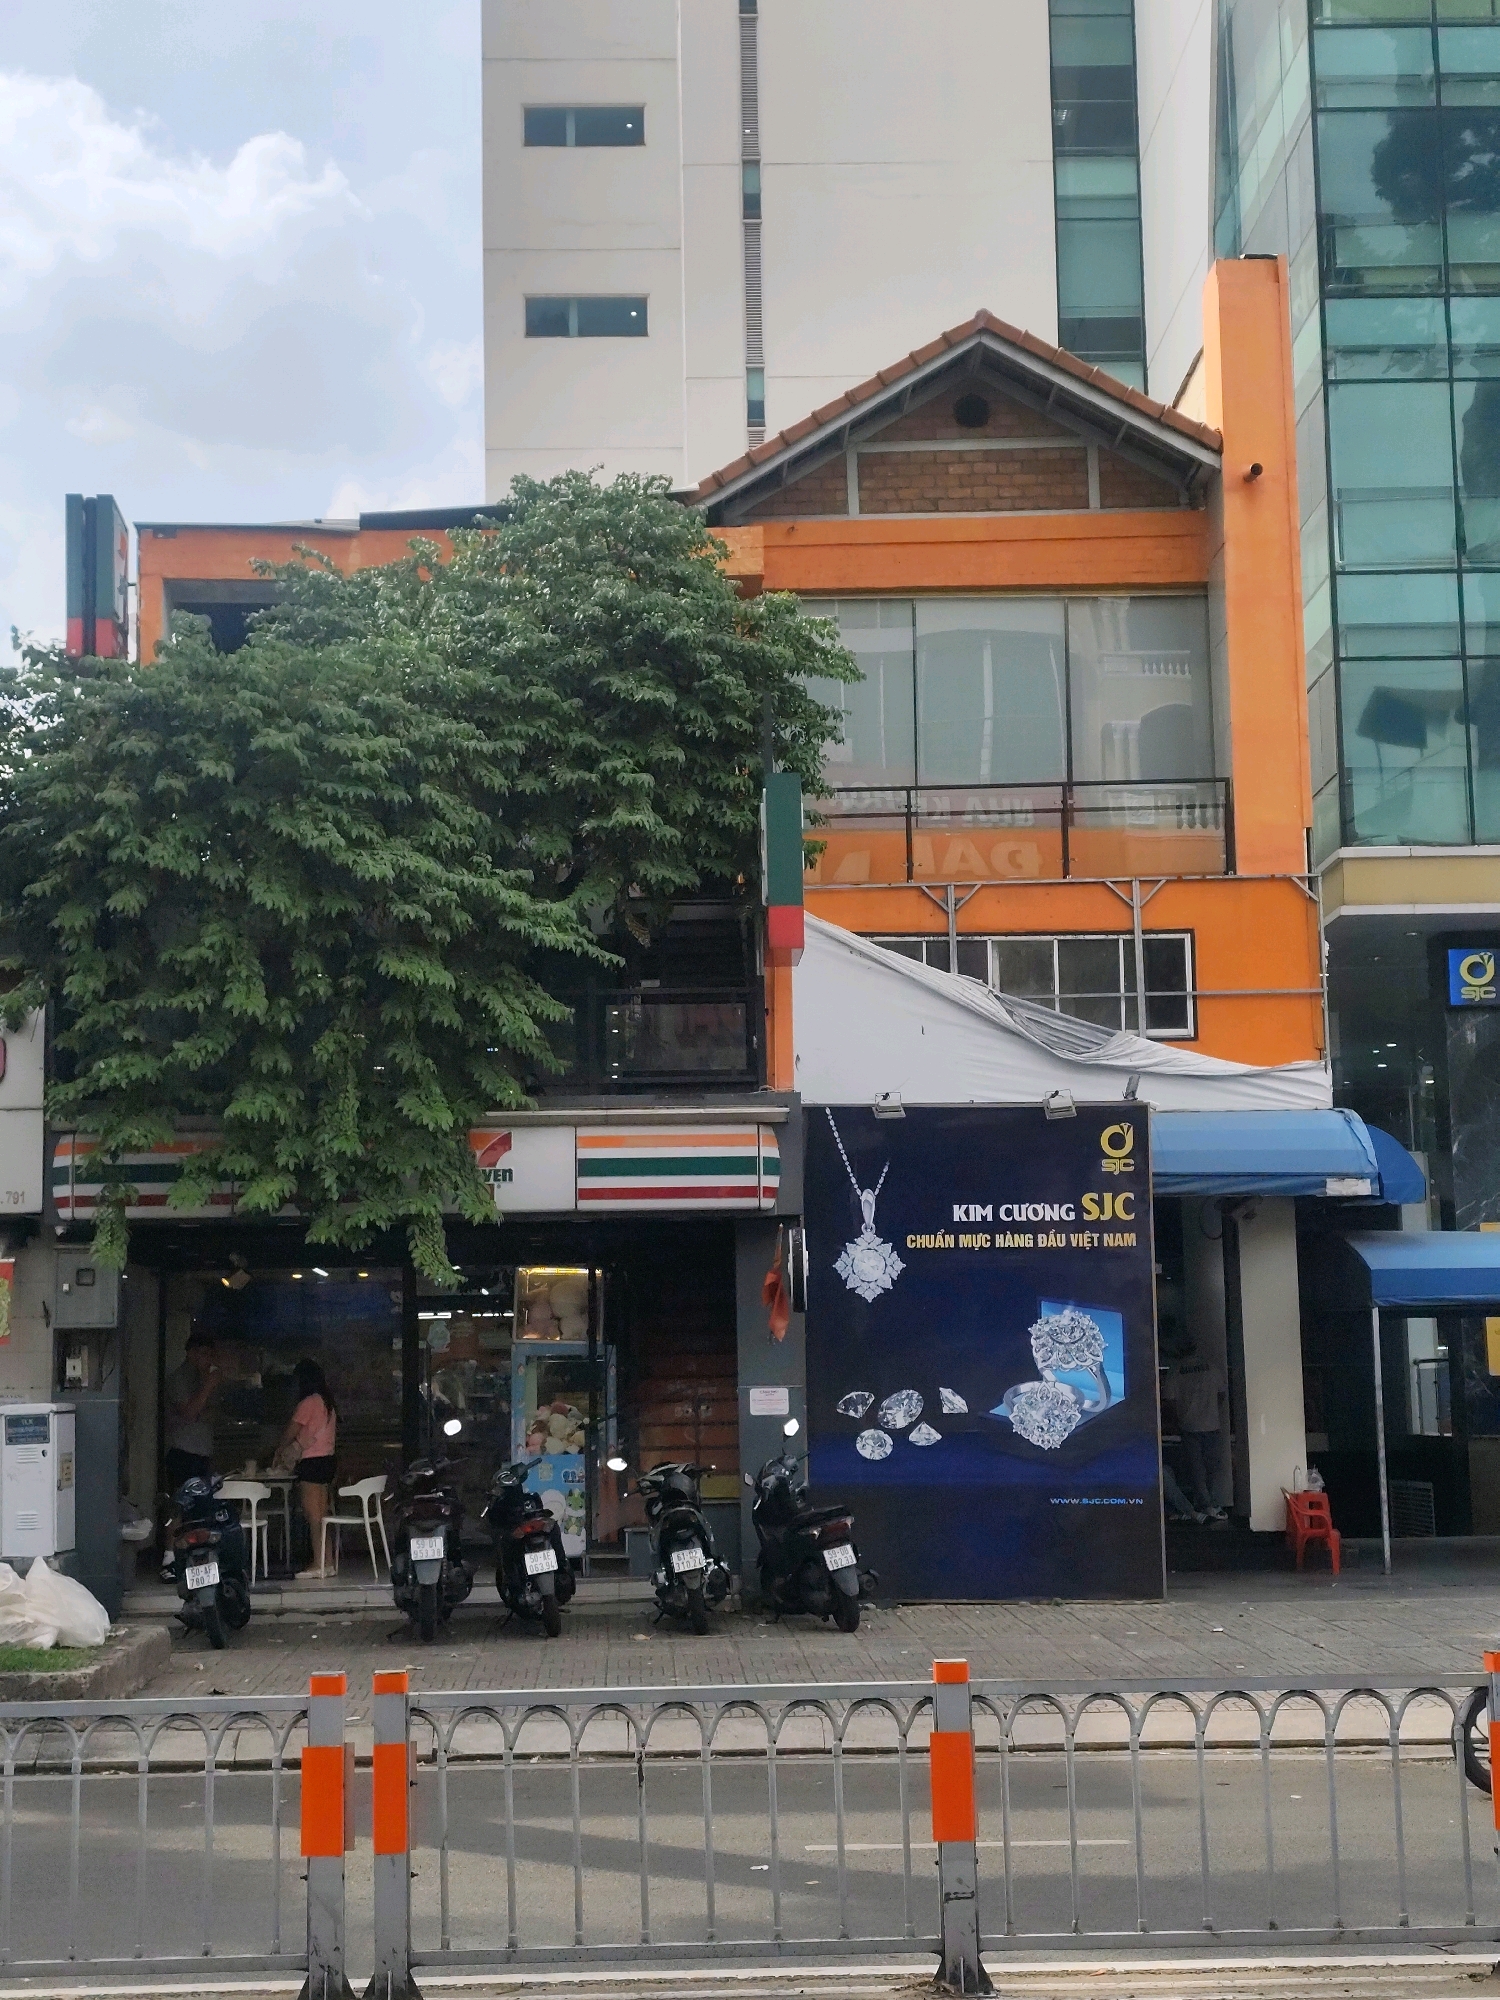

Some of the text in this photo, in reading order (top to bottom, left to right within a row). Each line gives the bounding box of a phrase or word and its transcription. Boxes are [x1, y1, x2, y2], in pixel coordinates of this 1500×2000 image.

[953, 1192, 1135, 1222] KIM CƯƠNG SJC
[907, 1228, 1137, 1251] CHUẨN MỰC HÀNG ĐẦU VIỆT NAM
[1050, 1497, 1144, 1505] WWW.SJC.COM.VN
